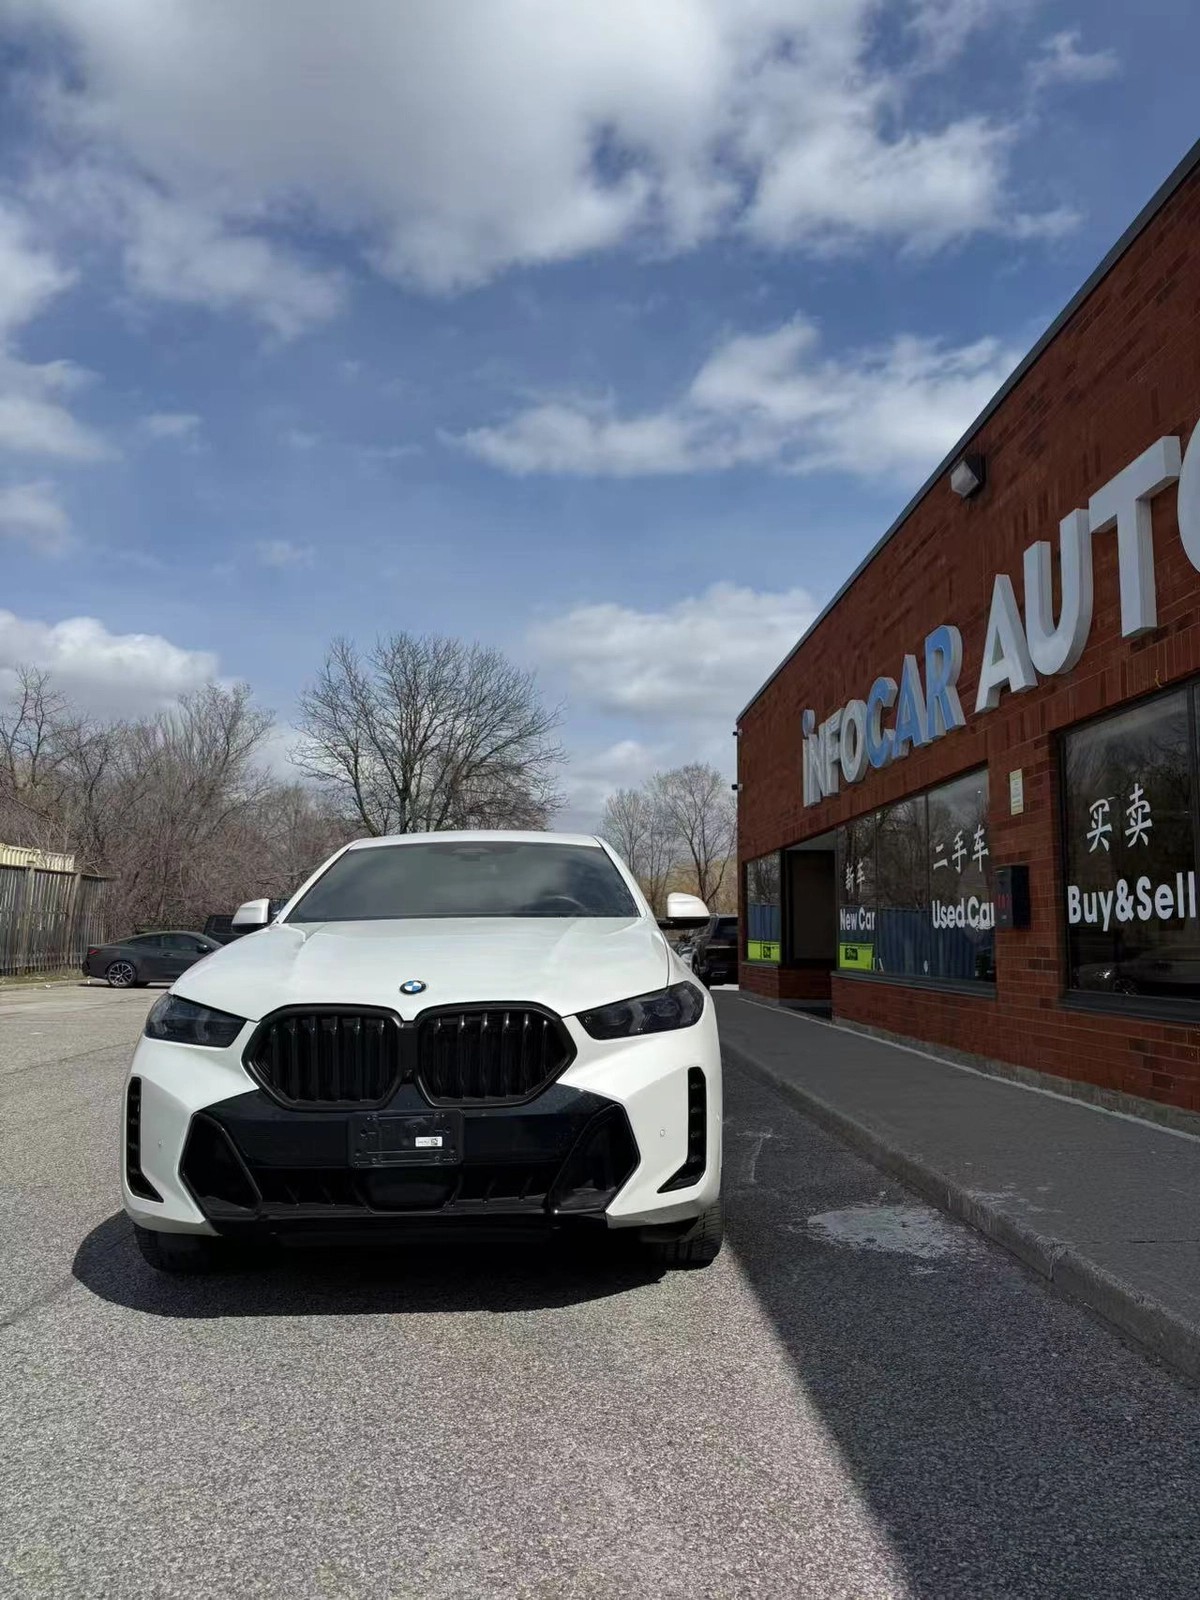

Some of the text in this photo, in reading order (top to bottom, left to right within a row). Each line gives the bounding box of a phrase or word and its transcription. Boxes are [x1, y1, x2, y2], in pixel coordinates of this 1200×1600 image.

[1086, 783, 1153, 853] 买卖
[933, 824, 989, 874] 二手车
[840, 906, 875, 931] New Car
[932, 898, 965, 929] Used
[1068, 871, 1196, 932] Buy&Sell
